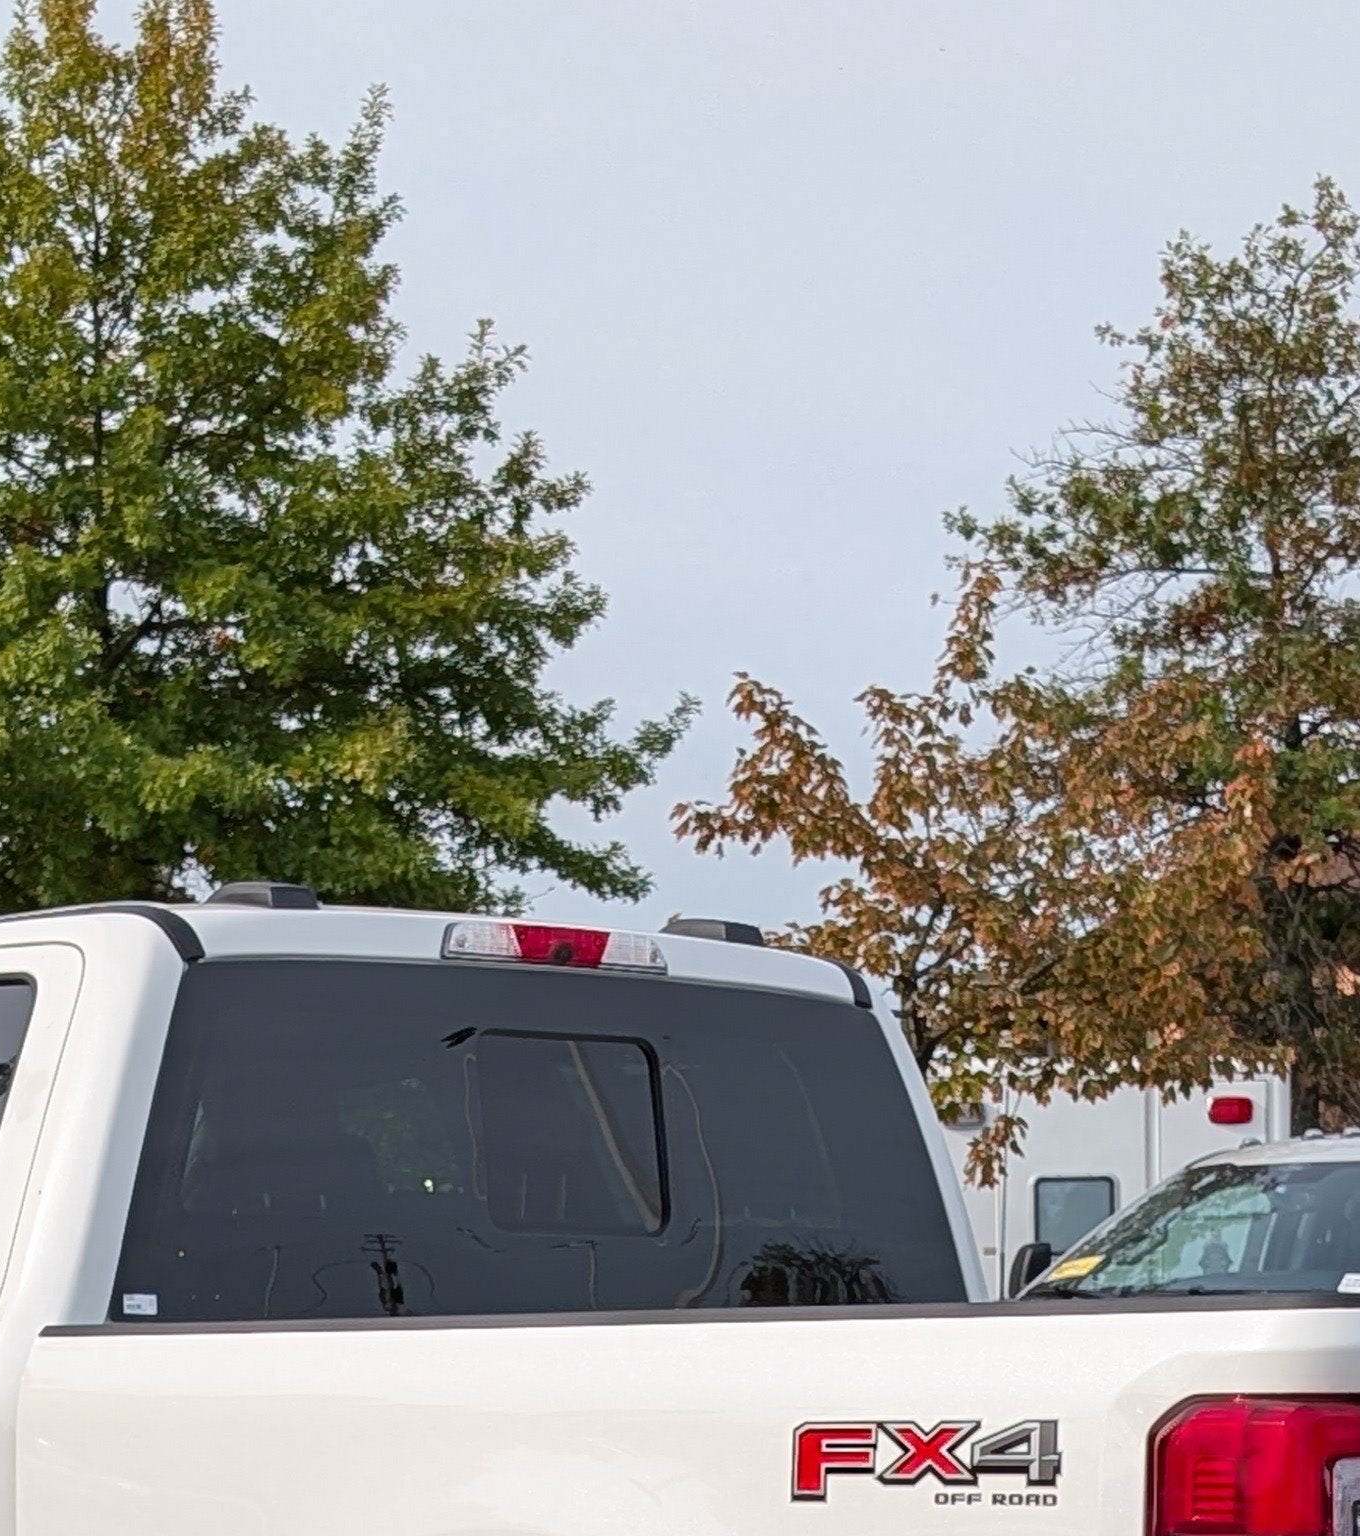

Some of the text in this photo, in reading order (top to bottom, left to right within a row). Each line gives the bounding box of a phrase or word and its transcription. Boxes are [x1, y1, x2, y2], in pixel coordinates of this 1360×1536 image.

[791, 1419, 1062, 1502] FX4
[934, 1492, 1058, 1506] OFF ROAD
